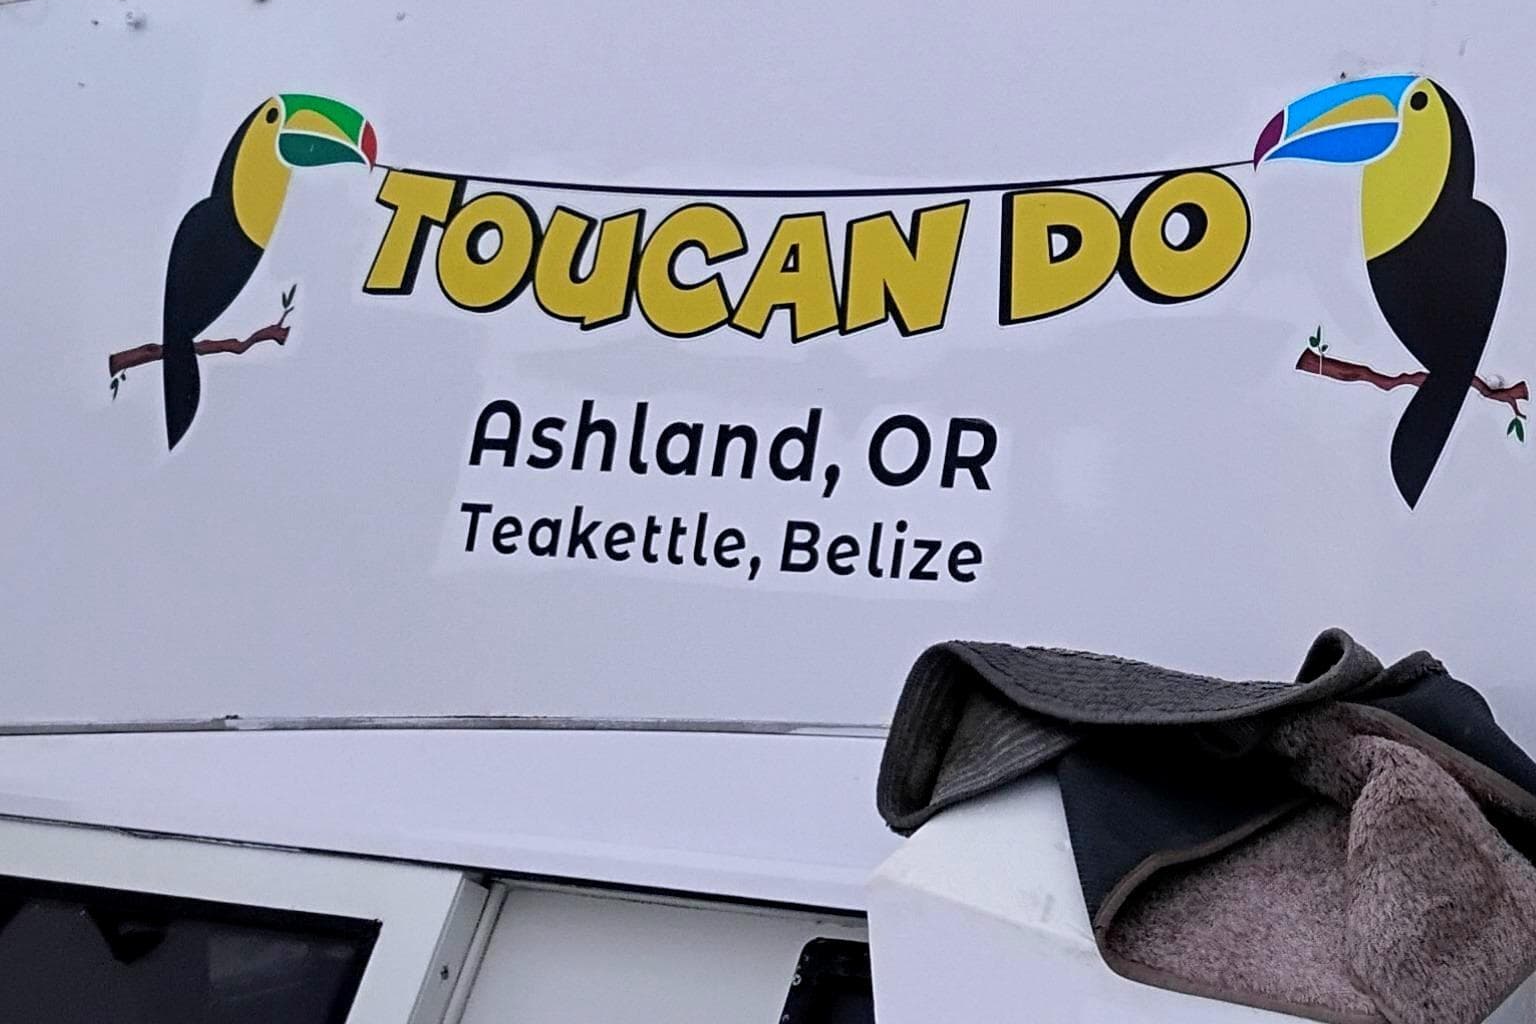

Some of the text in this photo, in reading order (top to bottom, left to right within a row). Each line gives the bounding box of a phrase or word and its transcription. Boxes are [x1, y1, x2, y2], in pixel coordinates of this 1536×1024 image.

[362, 167, 1251, 343] TOUCAN DO
[468, 399, 998, 498] Ashland, OR
[460, 502, 983, 583] Teakettle, Belize
